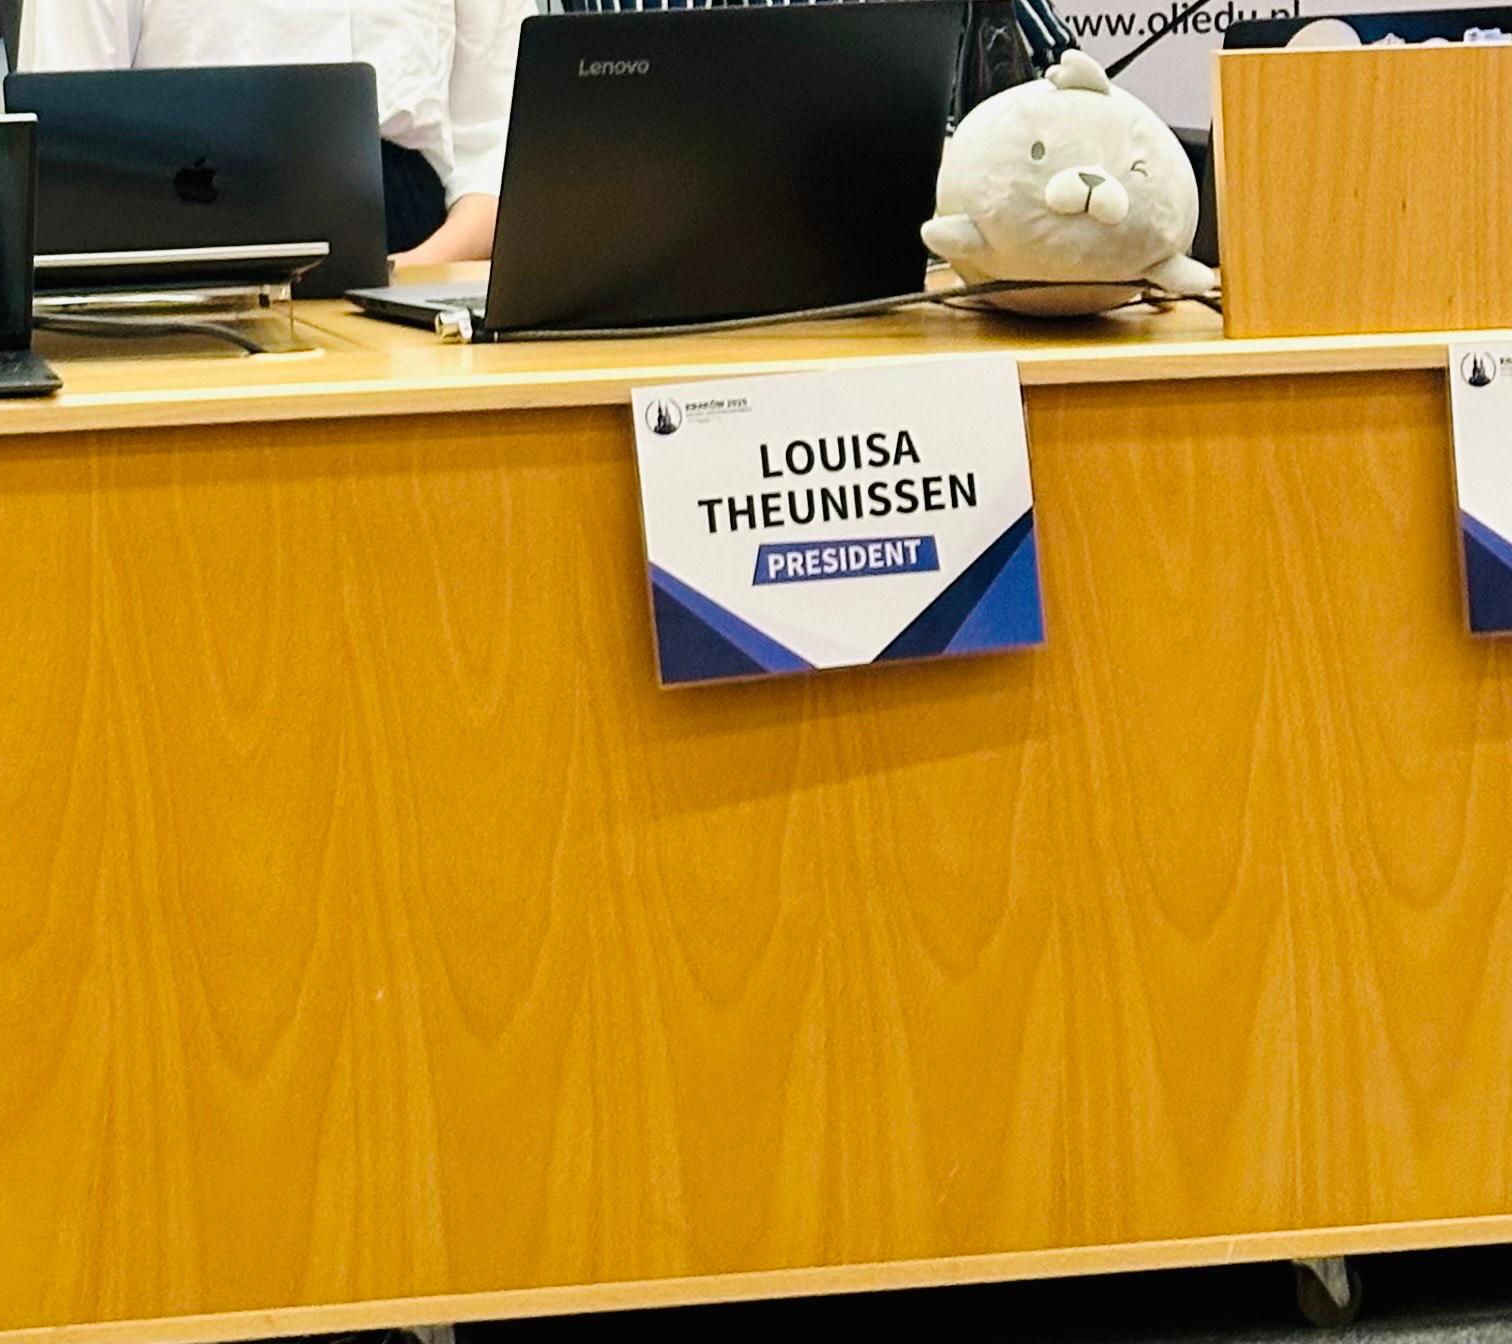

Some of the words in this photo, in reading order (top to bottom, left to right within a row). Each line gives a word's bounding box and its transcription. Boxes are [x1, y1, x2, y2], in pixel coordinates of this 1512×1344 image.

[578, 58, 650, 77] Lenovo
[759, 430, 921, 480] LOUISA
[698, 472, 978, 535] THEUNISSEN
[767, 538, 921, 580] PRESIDENT
